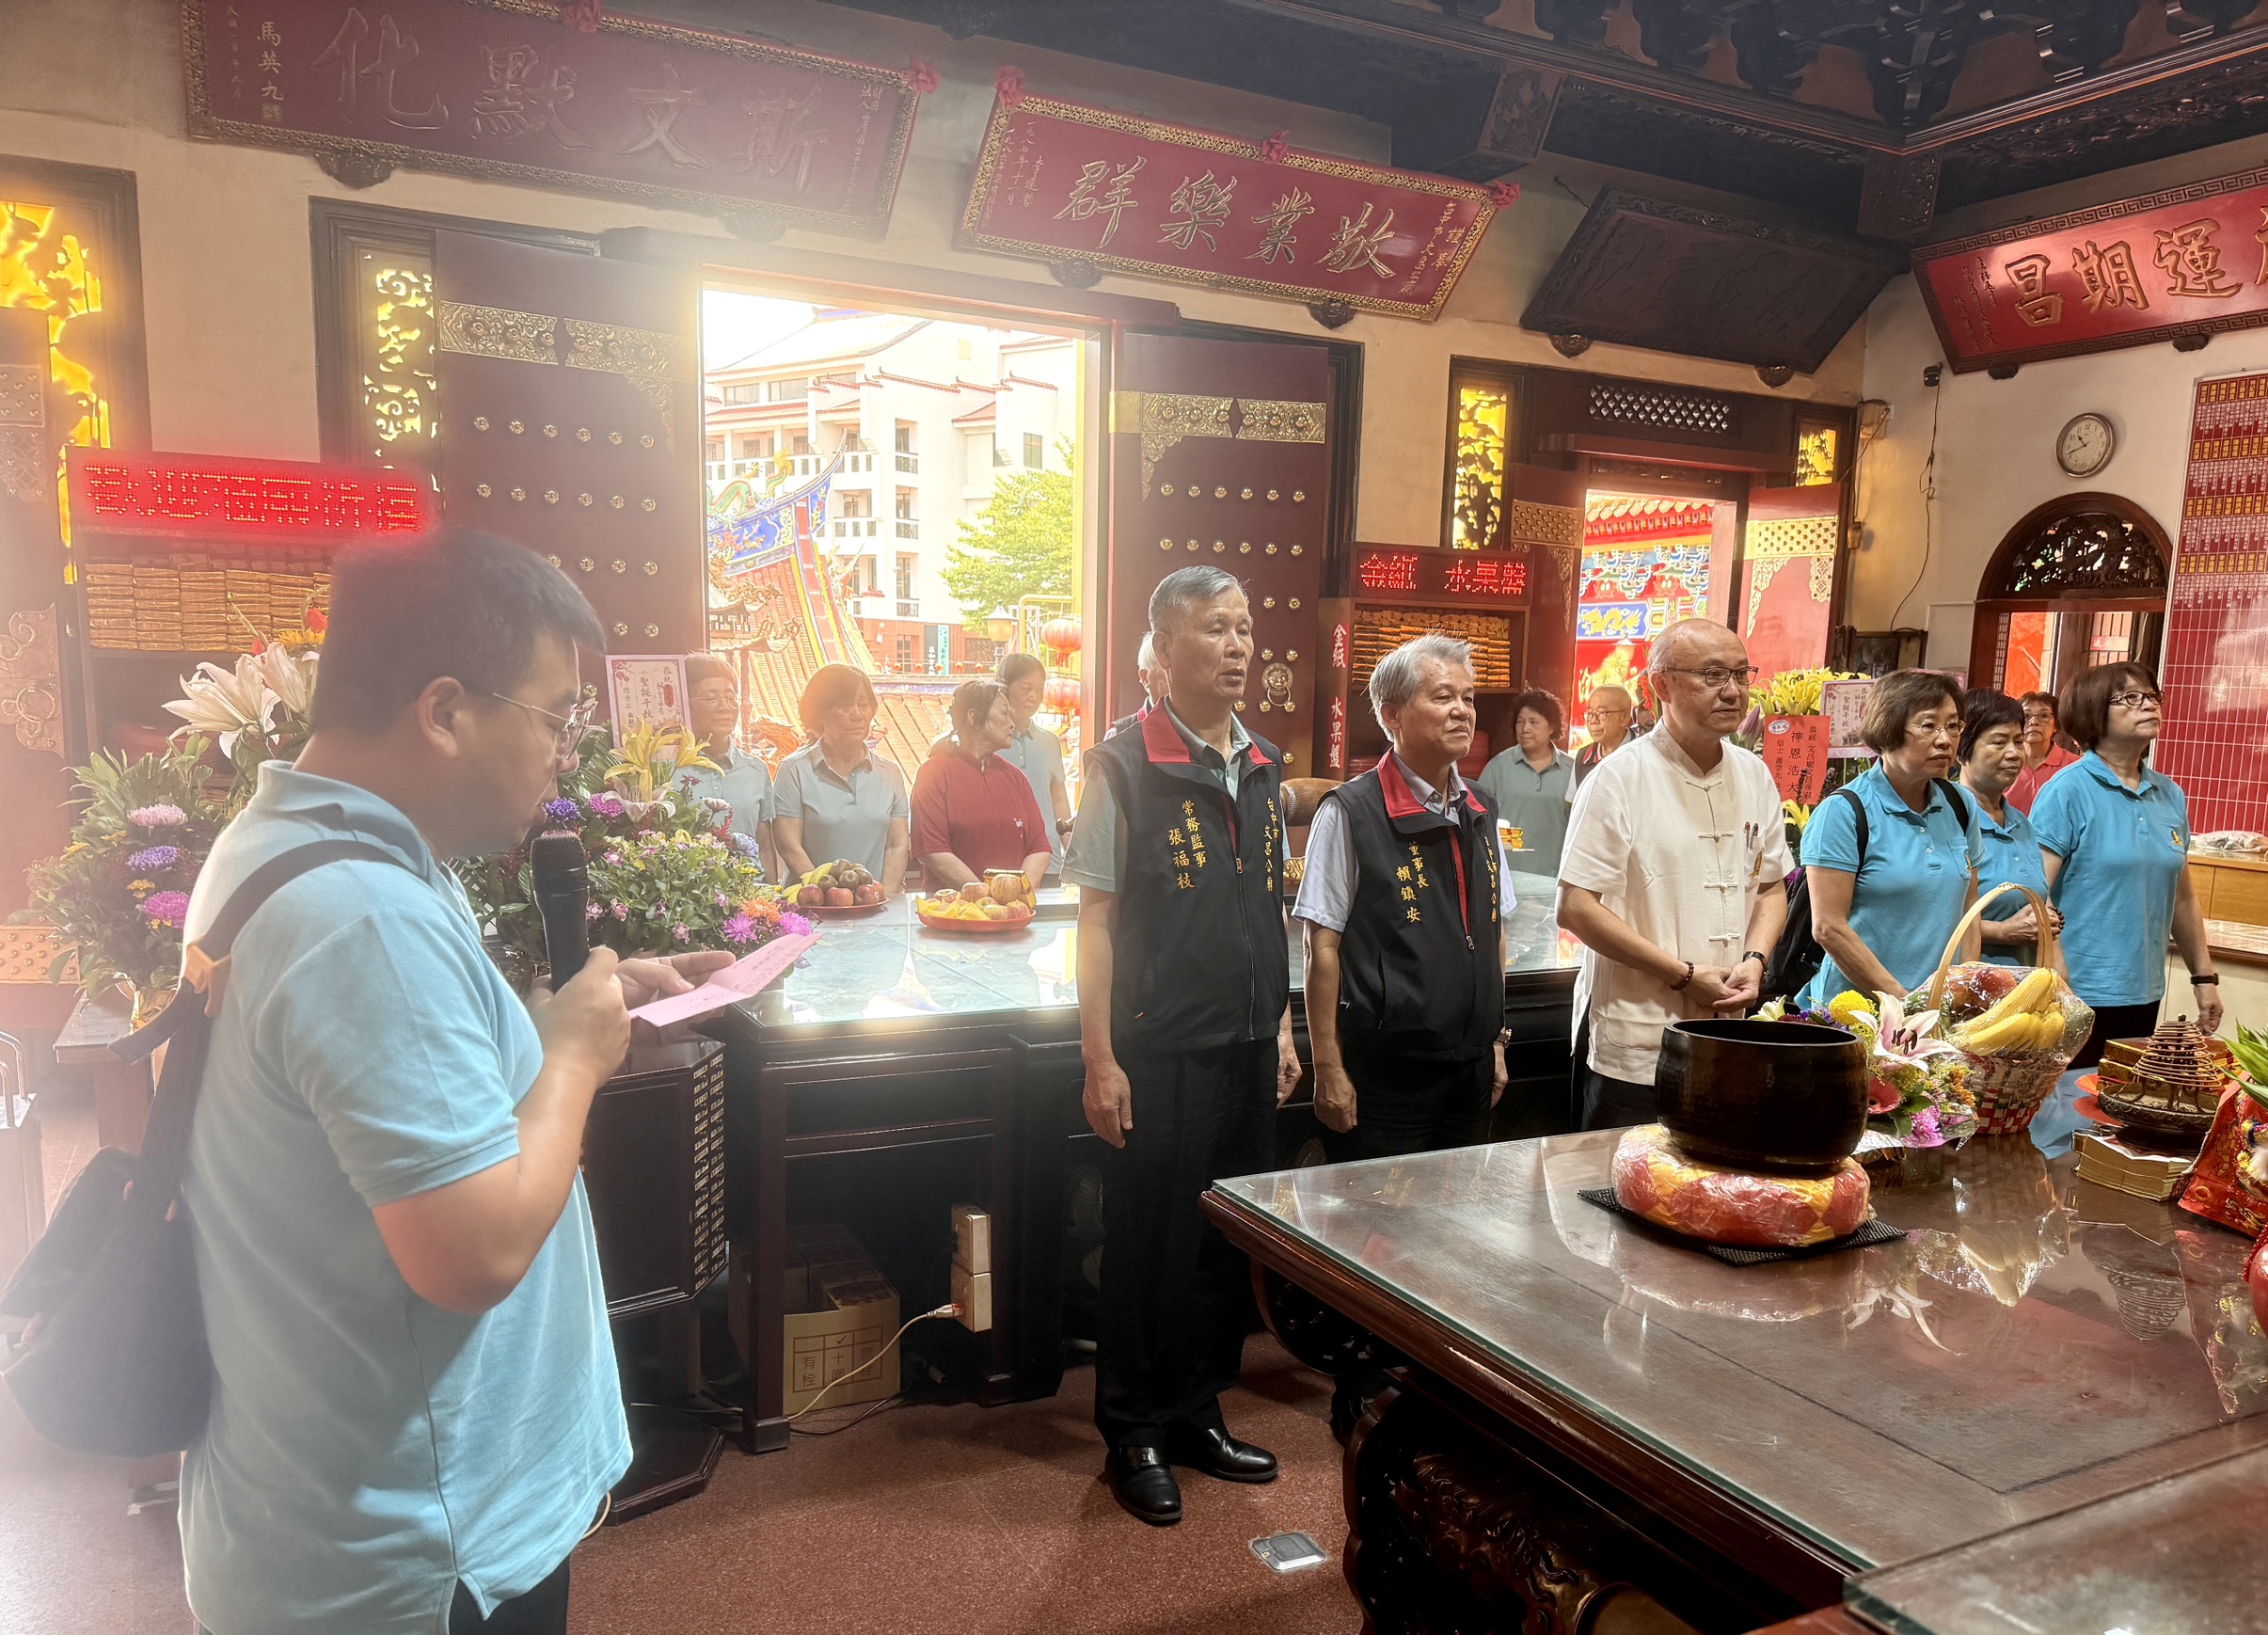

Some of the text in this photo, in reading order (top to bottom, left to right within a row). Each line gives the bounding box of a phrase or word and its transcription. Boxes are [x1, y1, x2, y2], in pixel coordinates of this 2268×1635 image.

[257, 20, 284, 101] 馬英九
[2004, 206, 2268, 327] 運期昌
[1359, 553, 1528, 595] 金紙 水果盤
[1331, 624, 1347, 669] 金紙
[640, 676, 654, 719] 聖誕千秋
[663, 665, 674, 683] 恭祝
[1329, 696, 1345, 769] 水果盤
[1842, 696, 1850, 727] 聖誕千秋
[1786, 731, 1803, 793] 神恩浩大
[1182, 800, 1207, 868] 常務監事
[1408, 839, 1430, 889] 董事長
[1396, 865, 1421, 923] 賴鎮安
[801, 1356, 817, 1388] 有栓
